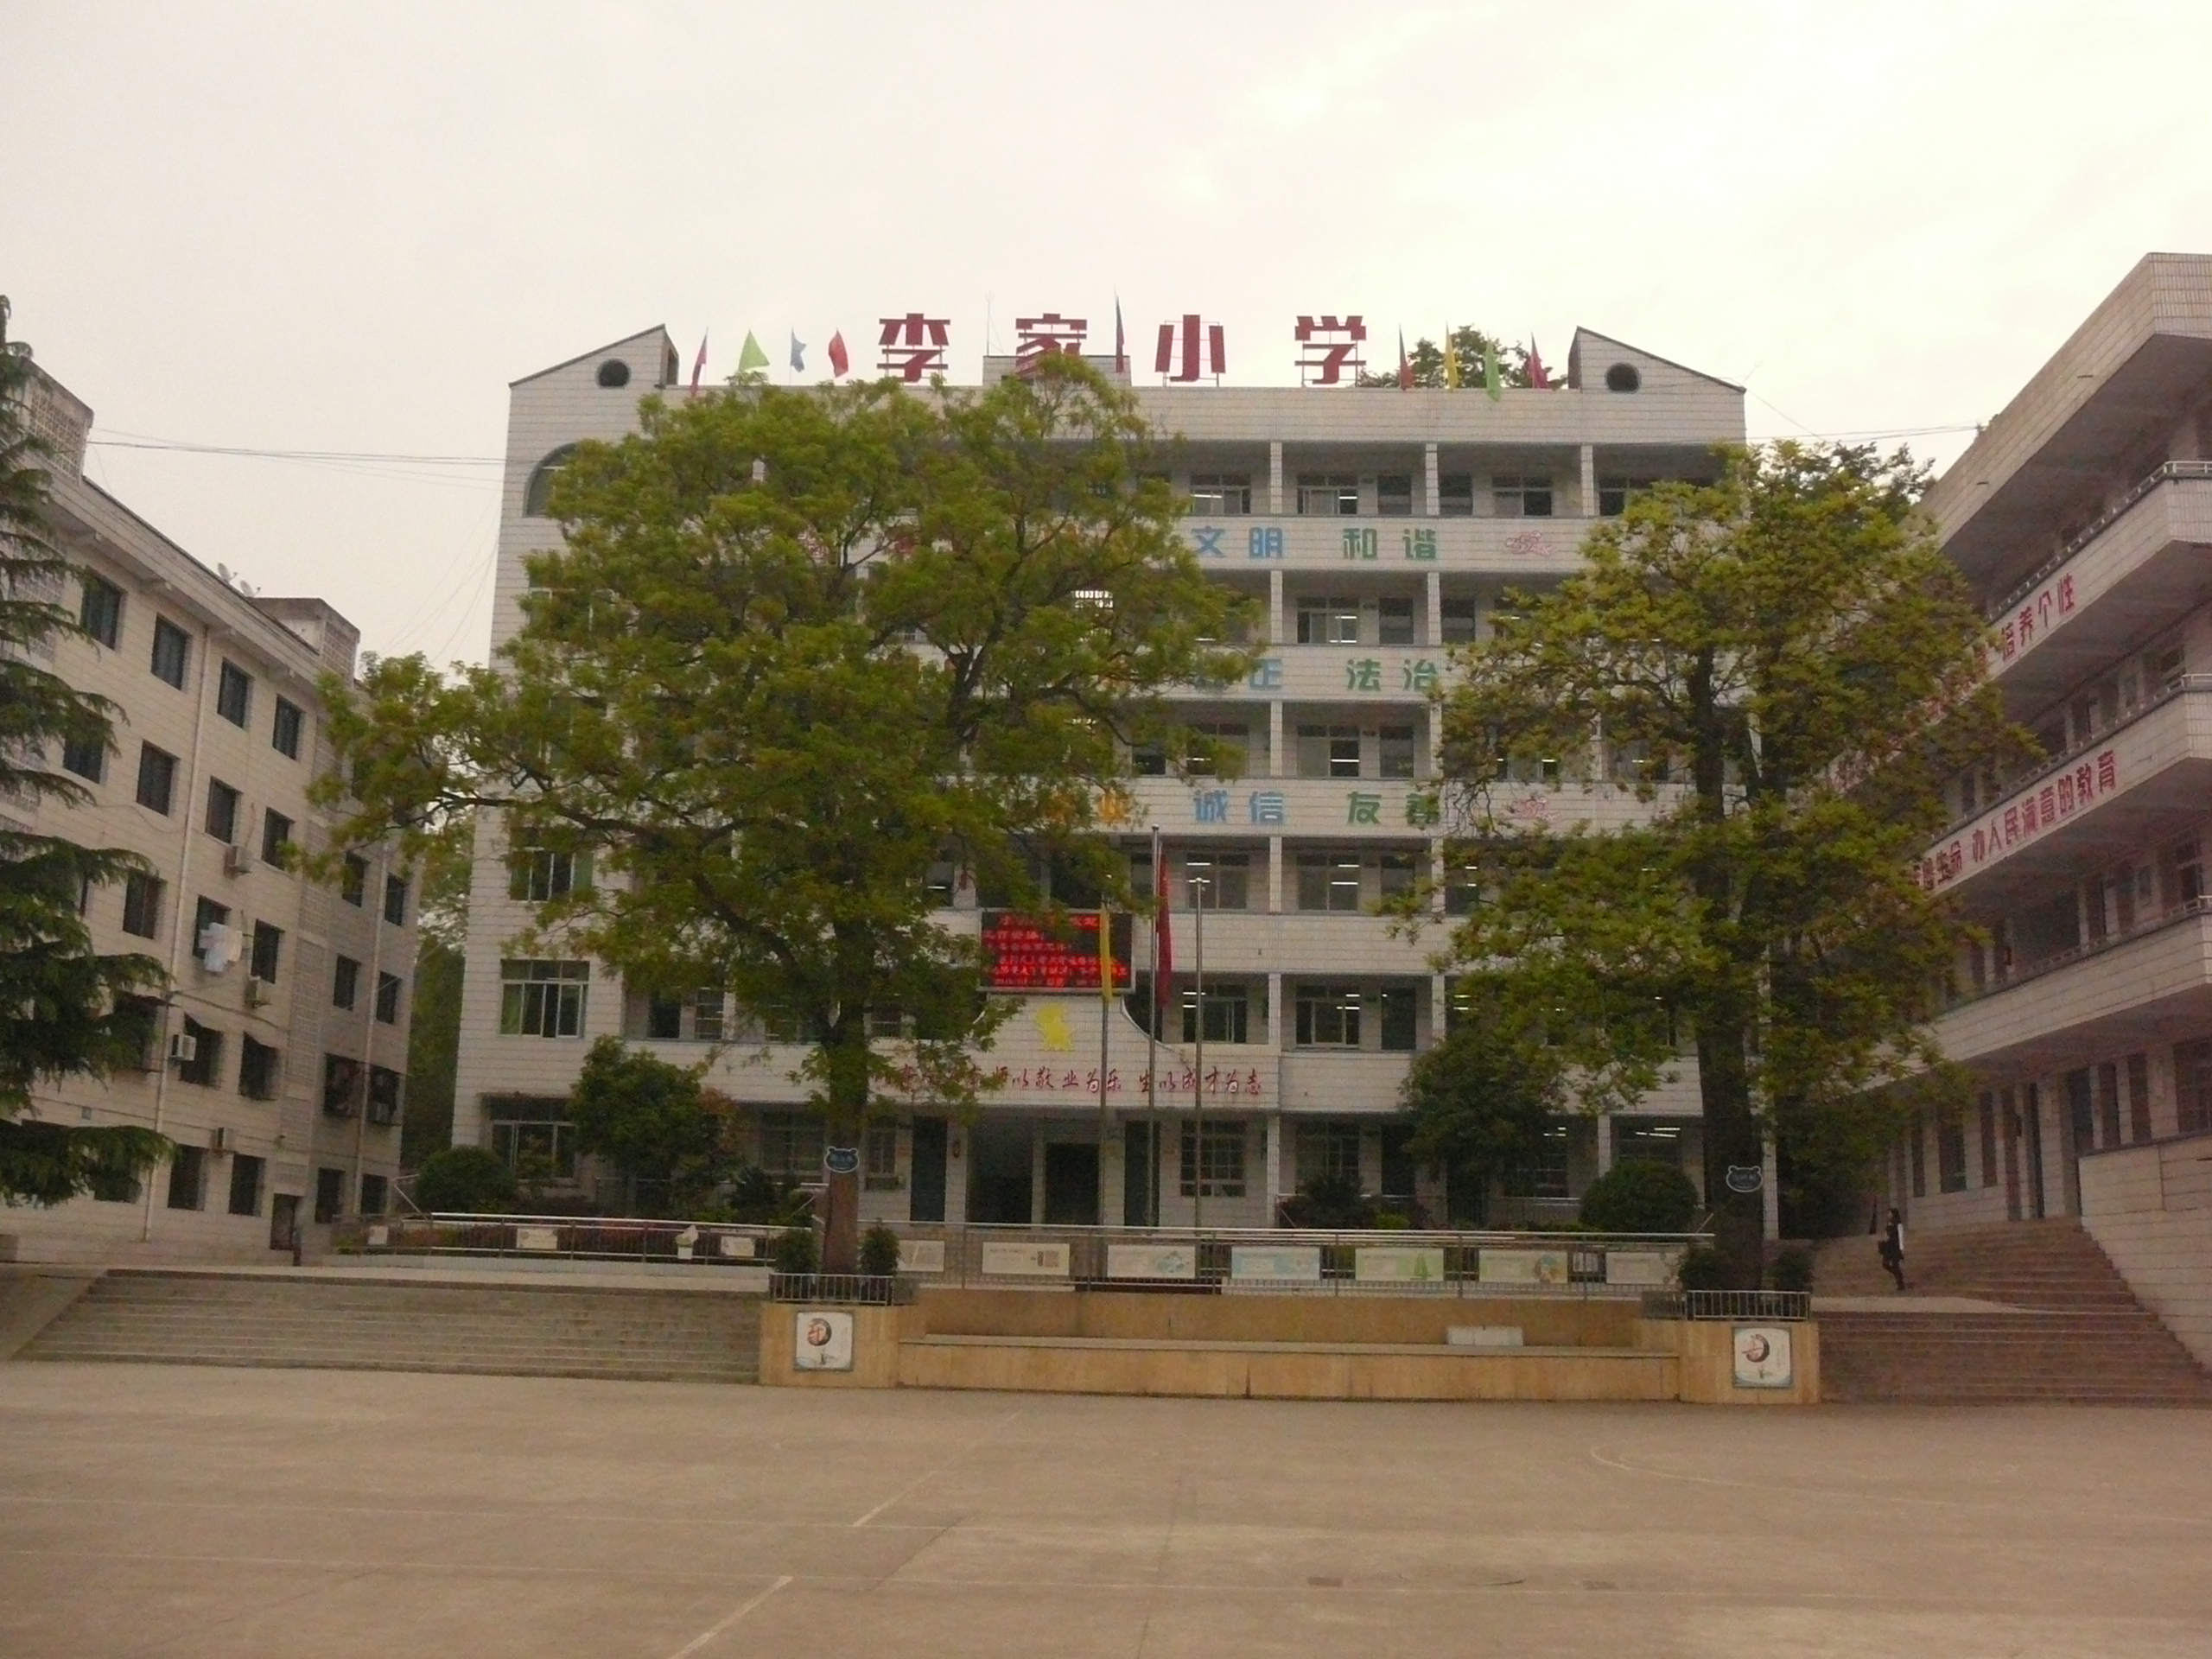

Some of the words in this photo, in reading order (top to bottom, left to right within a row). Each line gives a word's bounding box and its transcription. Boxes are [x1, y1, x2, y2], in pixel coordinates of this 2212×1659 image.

[877, 313, 1367, 385] 李家小学
[1192, 526, 1283, 559] 文明
[1343, 527, 1438, 562] 和谐
[2000, 572, 2075, 662] 培养个性
[1346, 658, 1438, 692] 法治
[1193, 790, 1285, 824] 诚信
[1971, 749, 2117, 864] 办人民满意的教育
